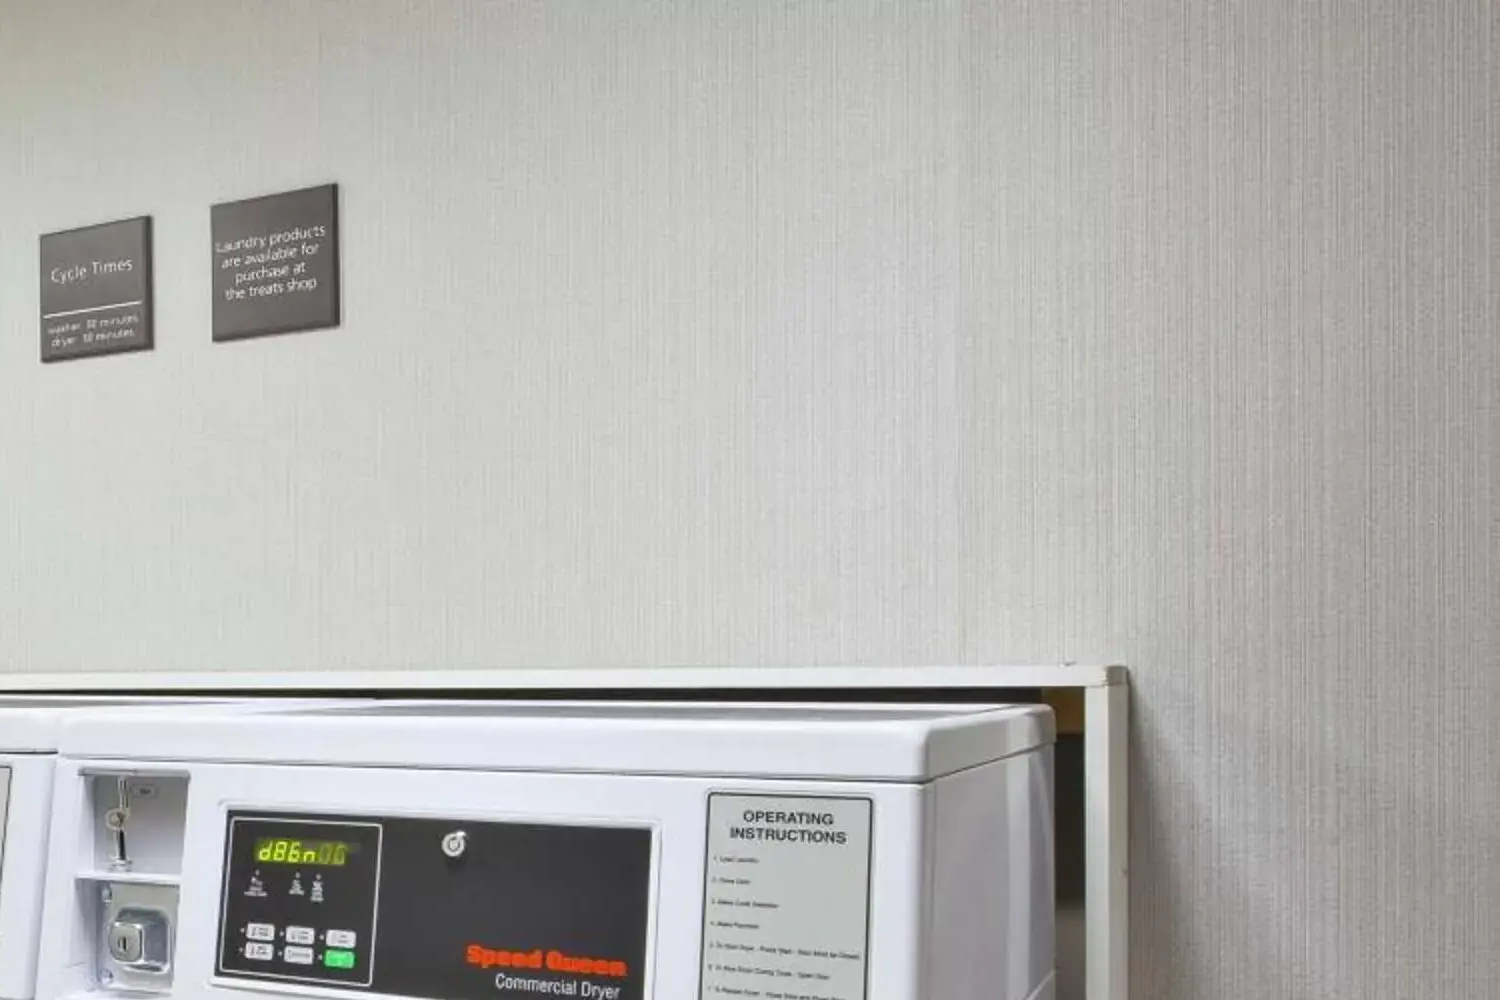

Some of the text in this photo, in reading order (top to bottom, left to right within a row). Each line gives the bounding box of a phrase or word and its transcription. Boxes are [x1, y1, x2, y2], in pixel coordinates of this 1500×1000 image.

[215, 225, 325, 253] Laundry products
[222, 241, 319, 269] are available for
[51, 259, 133, 284] Cycle Times
[235, 261, 306, 286] purchase at
[225, 278, 317, 301] the treats shop
[743, 809, 835, 825] OPERATING
[729, 826, 847, 845] INSTRUCTIONS
[467, 943, 628, 977] Speed Queen
[495, 972, 621, 1000] Commercial Dryer
